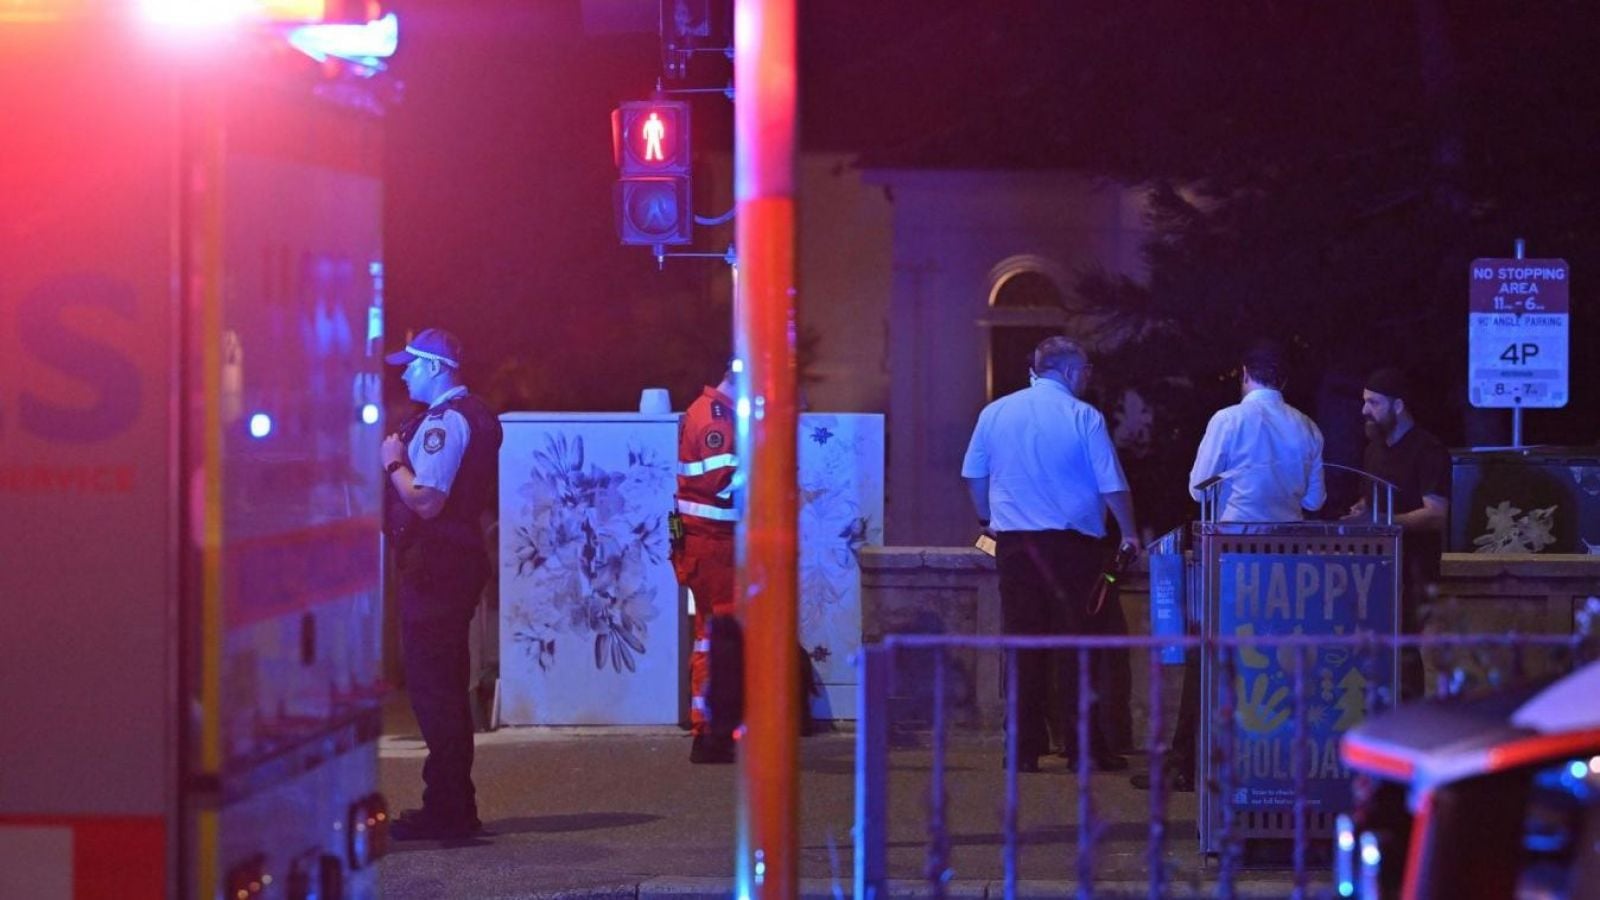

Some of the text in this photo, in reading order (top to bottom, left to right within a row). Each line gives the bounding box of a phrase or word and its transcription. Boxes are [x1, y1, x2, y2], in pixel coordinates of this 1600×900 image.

[1473, 268, 1565, 280] NO STOPPING
[1499, 282, 1539, 294] AREA
[1499, 343, 1539, 365] 4P
[1235, 562, 1375, 620] HAPPY
[1233, 738, 1350, 779] HOLIDA
